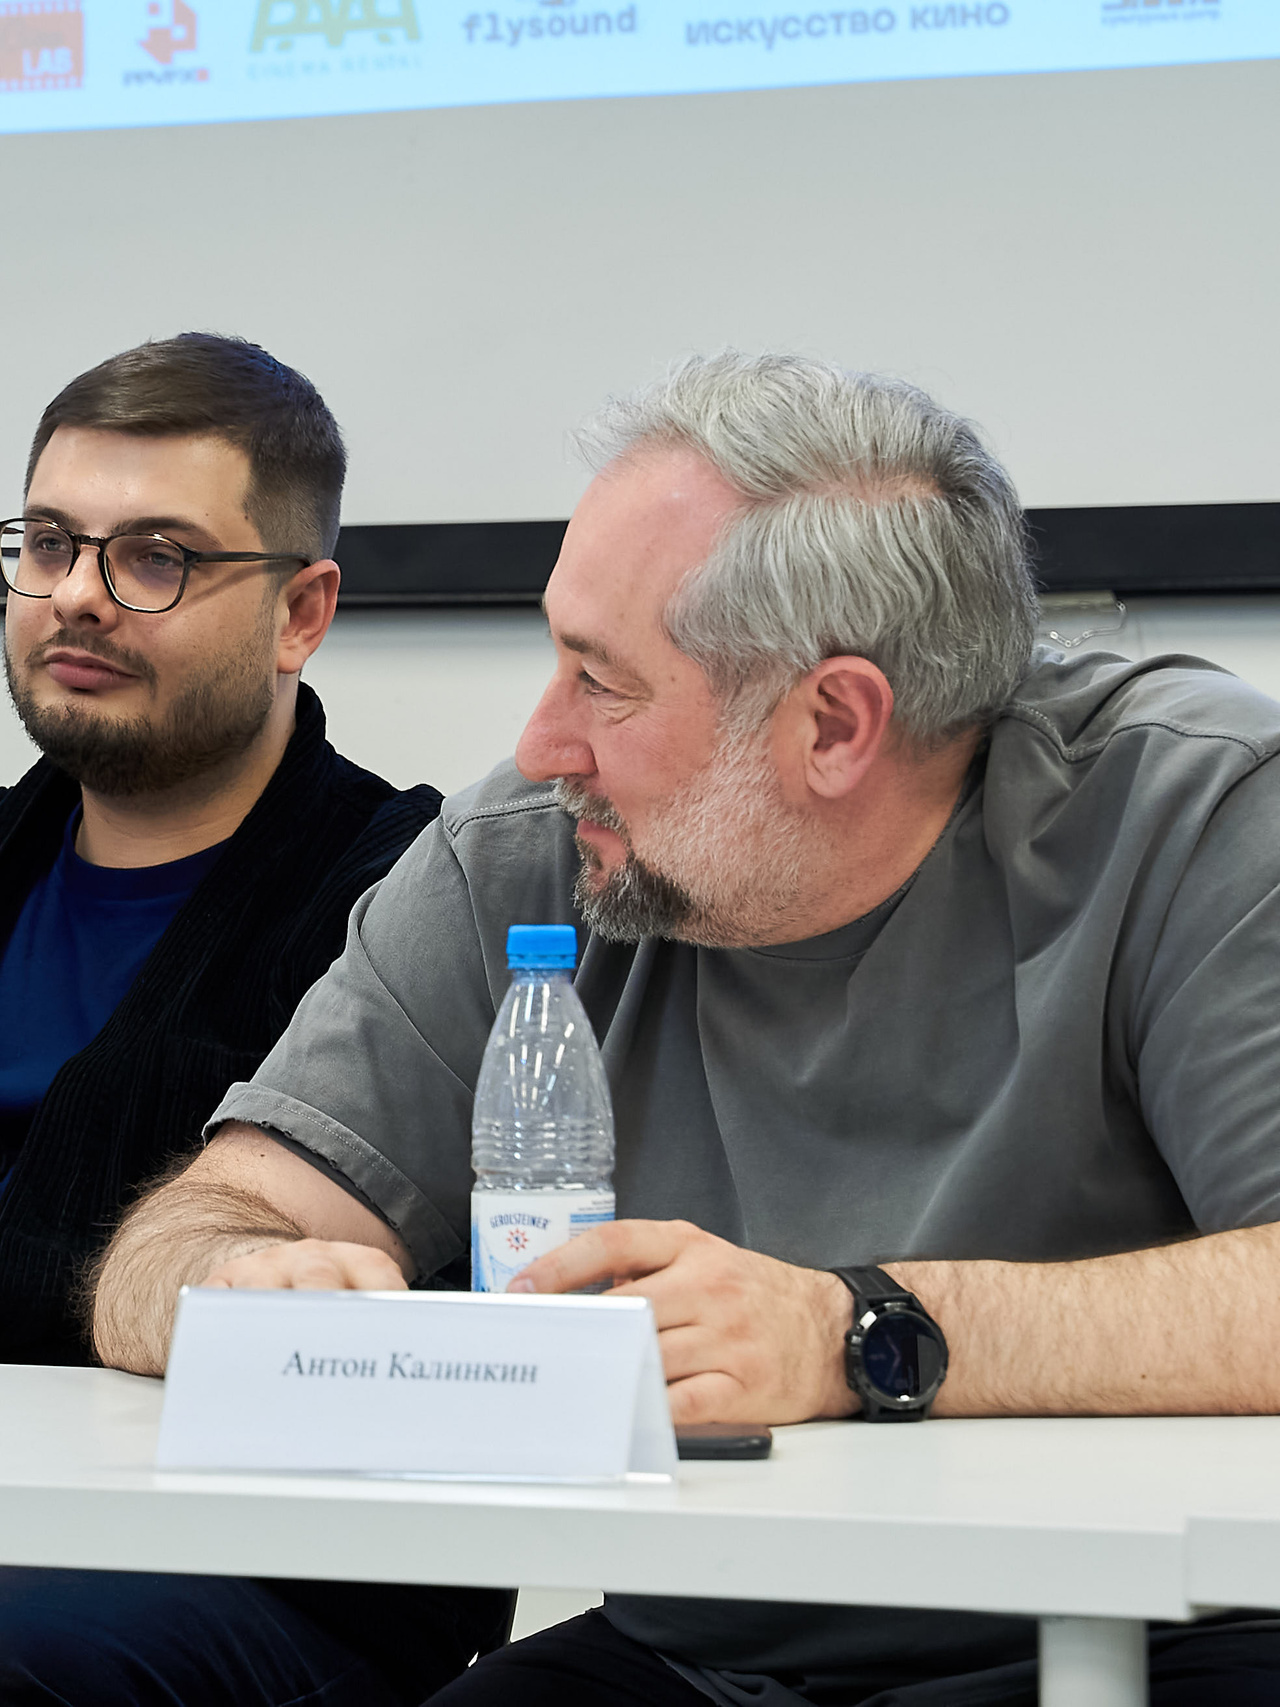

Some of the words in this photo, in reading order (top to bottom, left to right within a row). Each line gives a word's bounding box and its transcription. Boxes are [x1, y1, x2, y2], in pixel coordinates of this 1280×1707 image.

[462, 2, 637, 47] flysound
[22, 46, 73, 76] LAB
[490, 1213, 550, 1230] GEROLSTEINER
[282, 1351, 377, 1378] Антон
[388, 1353, 539, 1384] Калинкин
